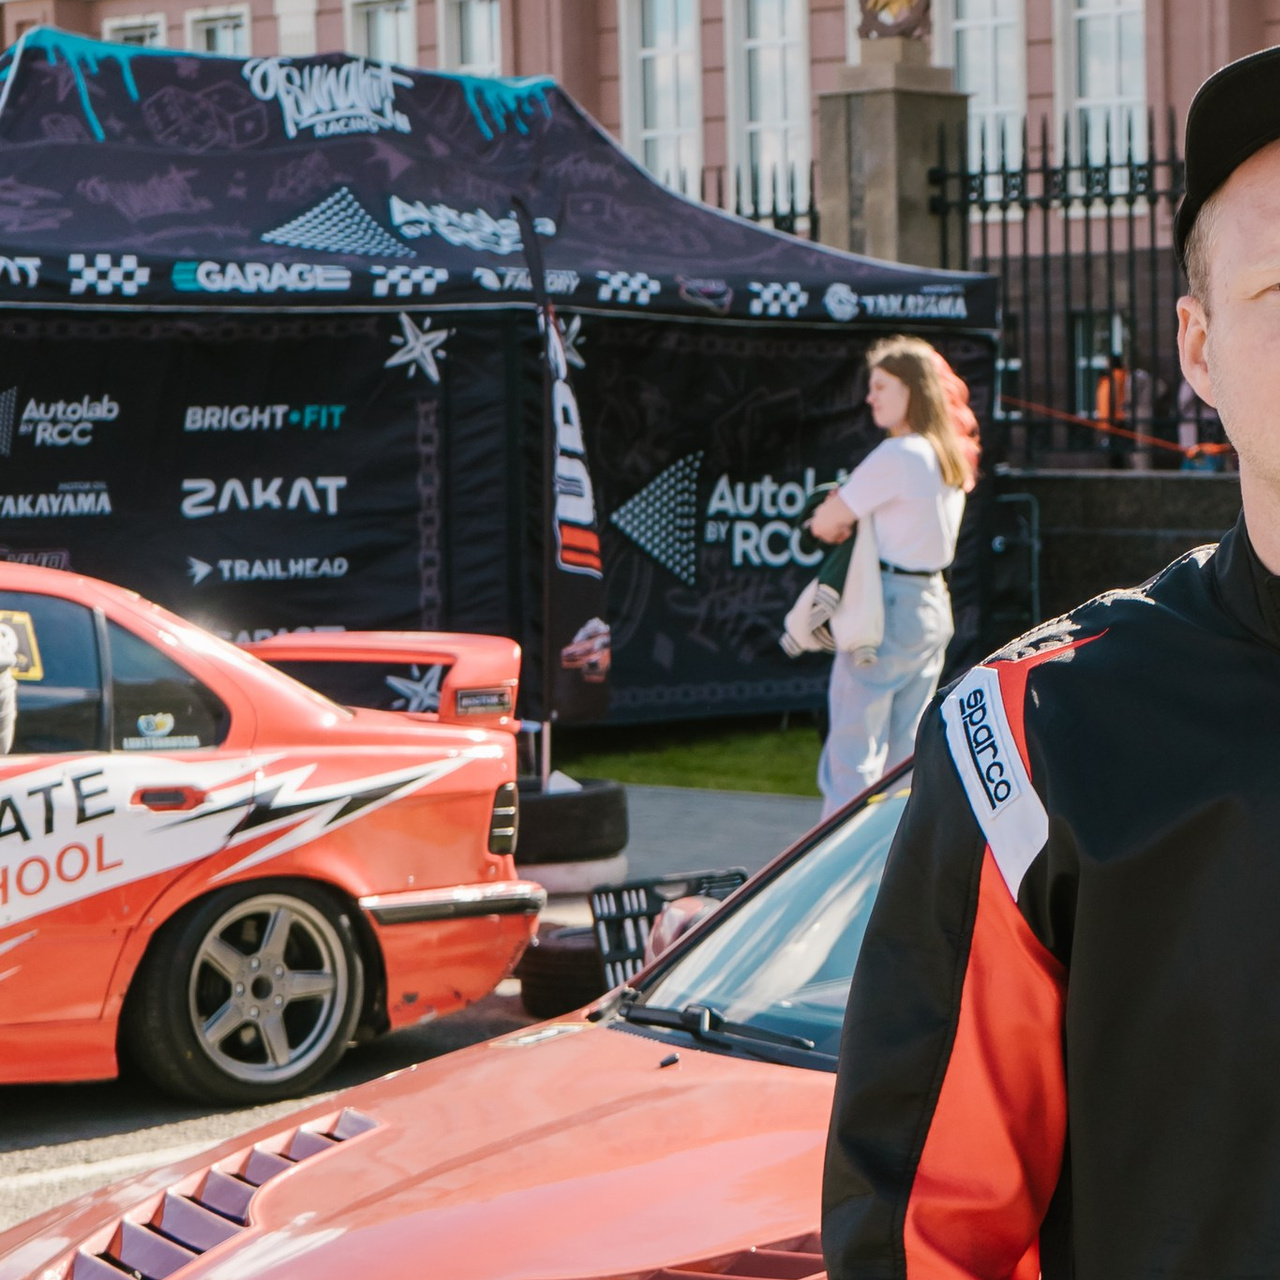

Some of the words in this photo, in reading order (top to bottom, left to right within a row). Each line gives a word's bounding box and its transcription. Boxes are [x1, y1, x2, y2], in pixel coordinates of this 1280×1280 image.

[22, 394, 119, 421] Autolab
[35, 421, 93, 446] RCC
[0, 491, 112, 518] AKAYAMA
[181, 476, 348, 518] ZAKAT
[704, 522, 730, 542] BY
[217, 557, 349, 581] TRAILHEAD
[961, 687, 1011, 809] sparco
